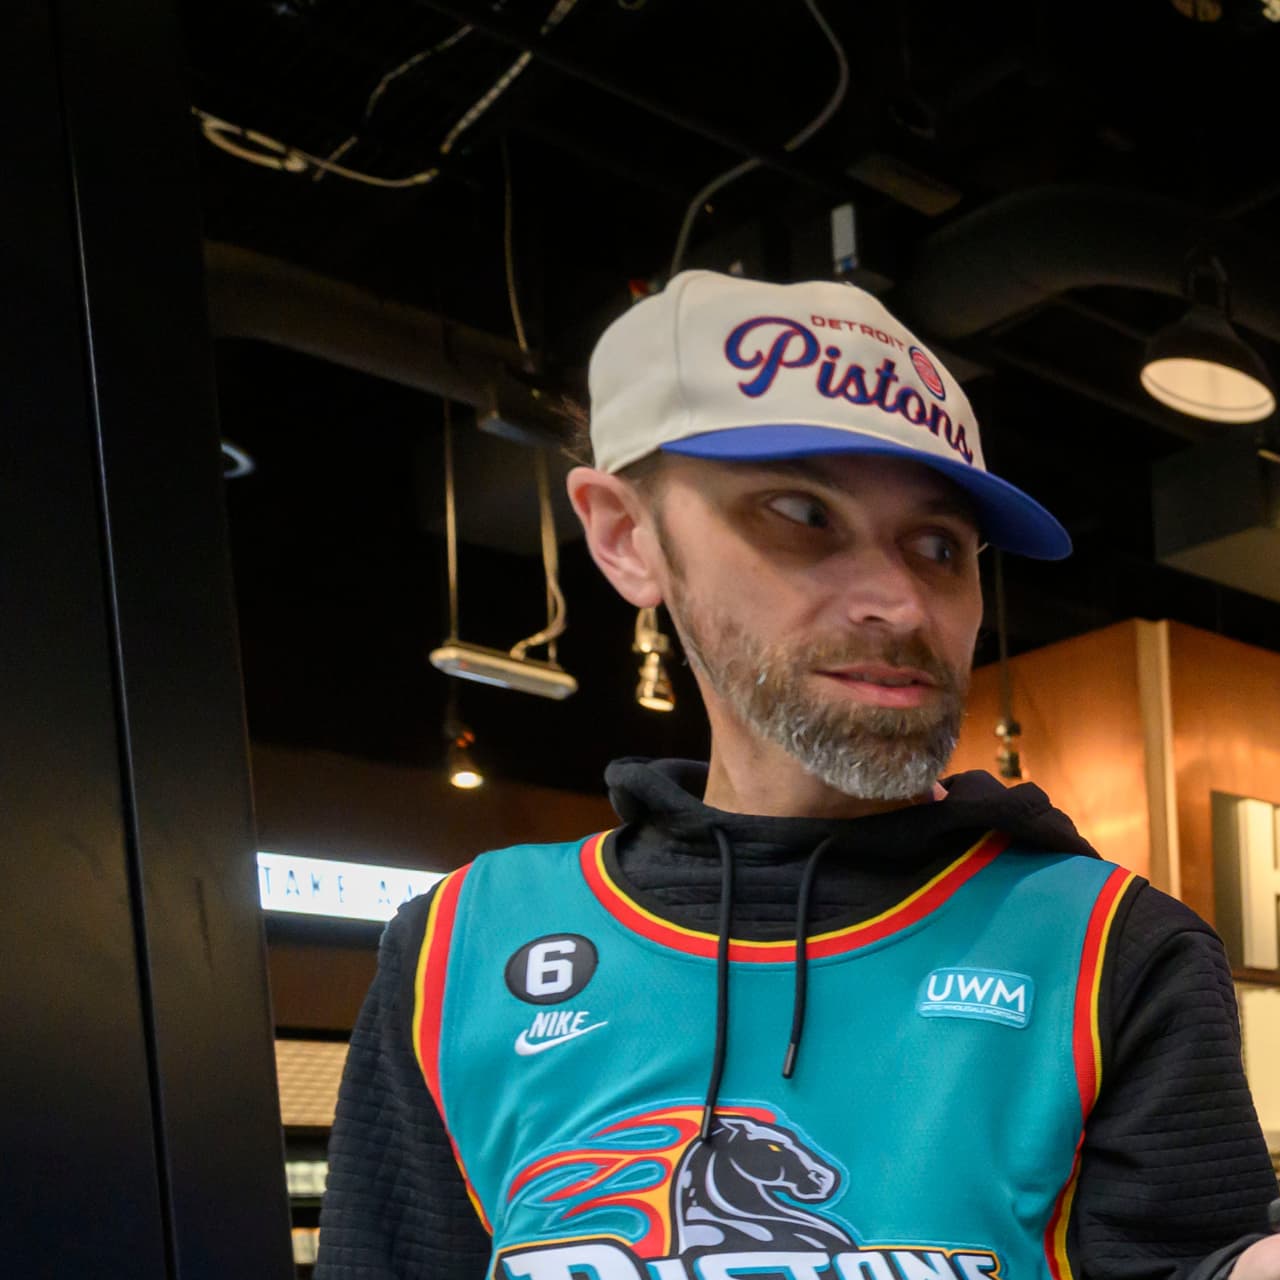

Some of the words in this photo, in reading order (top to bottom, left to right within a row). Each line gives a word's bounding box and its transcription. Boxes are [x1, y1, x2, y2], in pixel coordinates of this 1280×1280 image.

[810, 314, 907, 352] DETROIT
[724, 316, 974, 465] Pistons
[525, 939, 577, 997] 6
[927, 974, 1026, 1013] UWM
[528, 1010, 590, 1038] NIKE
